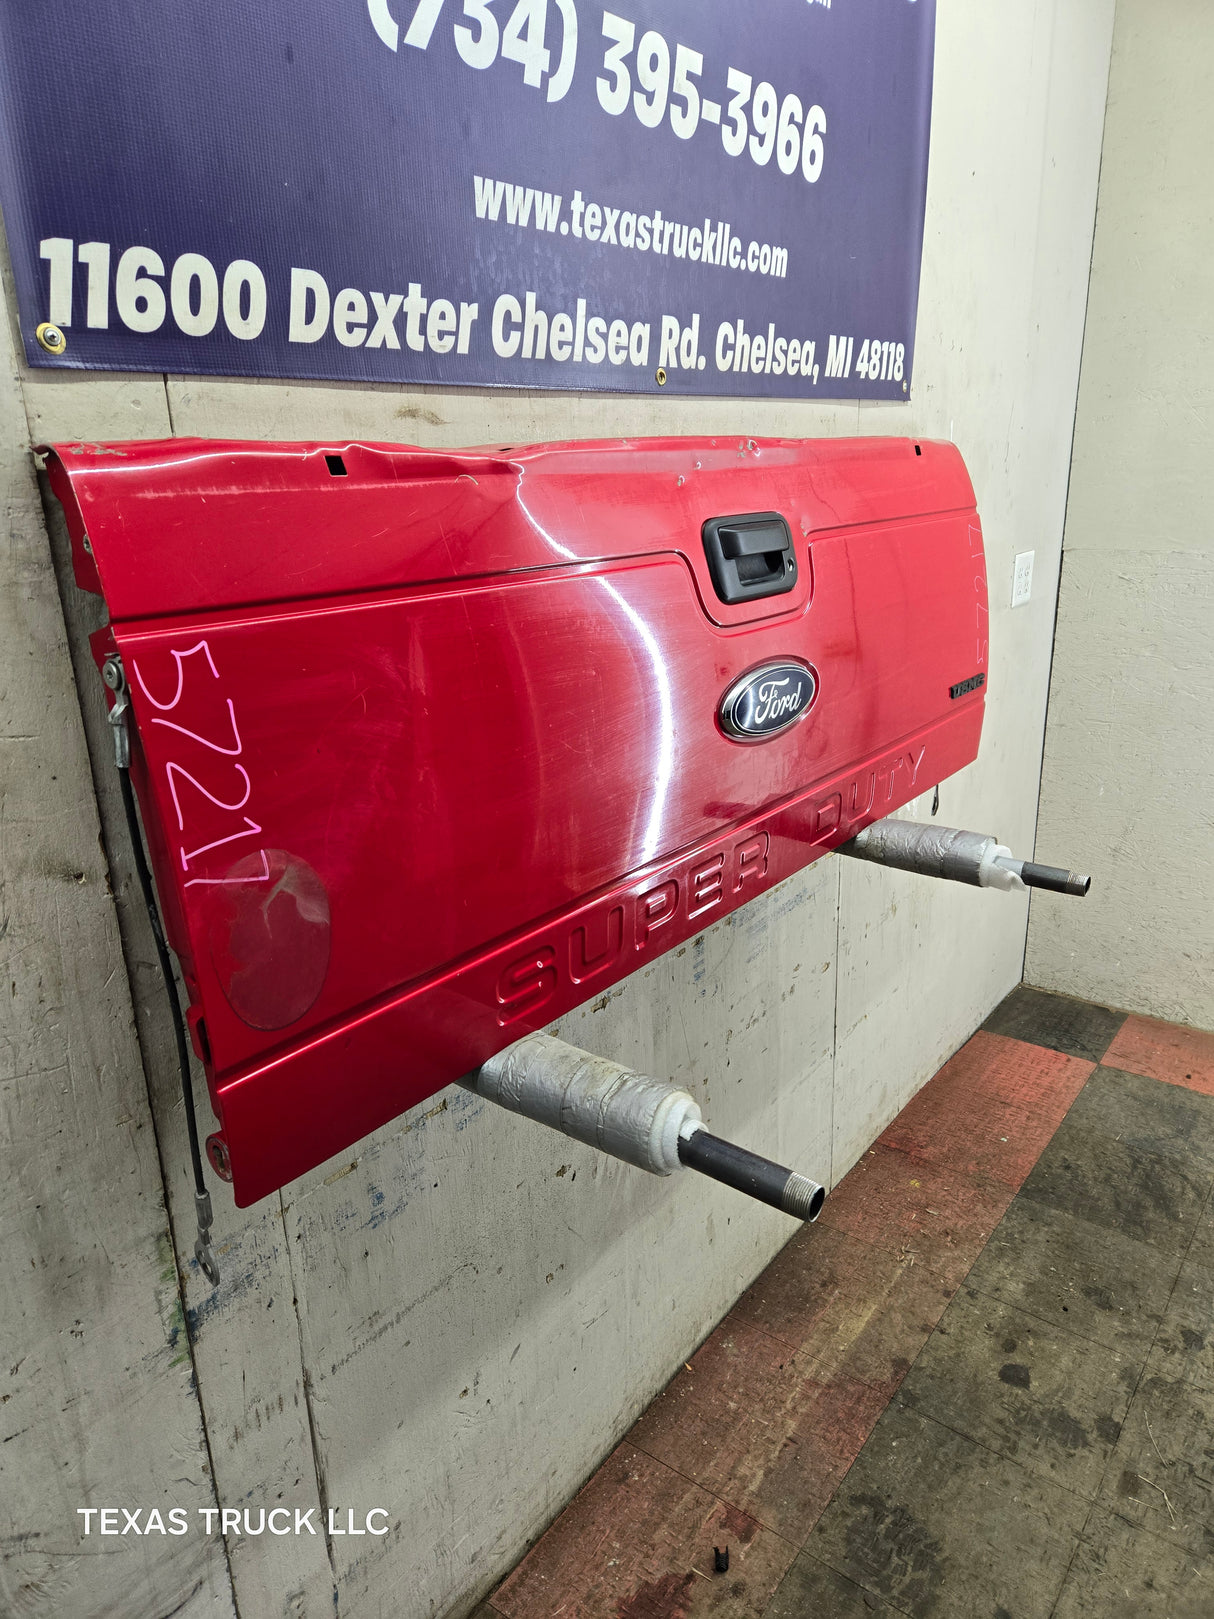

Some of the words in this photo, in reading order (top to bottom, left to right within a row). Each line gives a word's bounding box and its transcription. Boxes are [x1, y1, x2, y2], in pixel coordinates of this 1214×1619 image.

[595, 10, 828, 184] 395-3966
[473, 175, 789, 278] www.texastruckllc.com
[39, 237, 267, 341] 11600
[288, 267, 480, 355] Dexter
[491, 291, 652, 367] Chelsea
[659, 313, 707, 371] Rd.
[715, 318, 820, 385] Chelsea,
[825, 334, 854, 378] MI
[856, 338, 906, 382] 48118
[132, 639, 270, 888] 57217
[754, 676, 802, 724] Ford
[495, 829, 771, 1028] SUPER
[808, 743, 926, 848] DUTY
